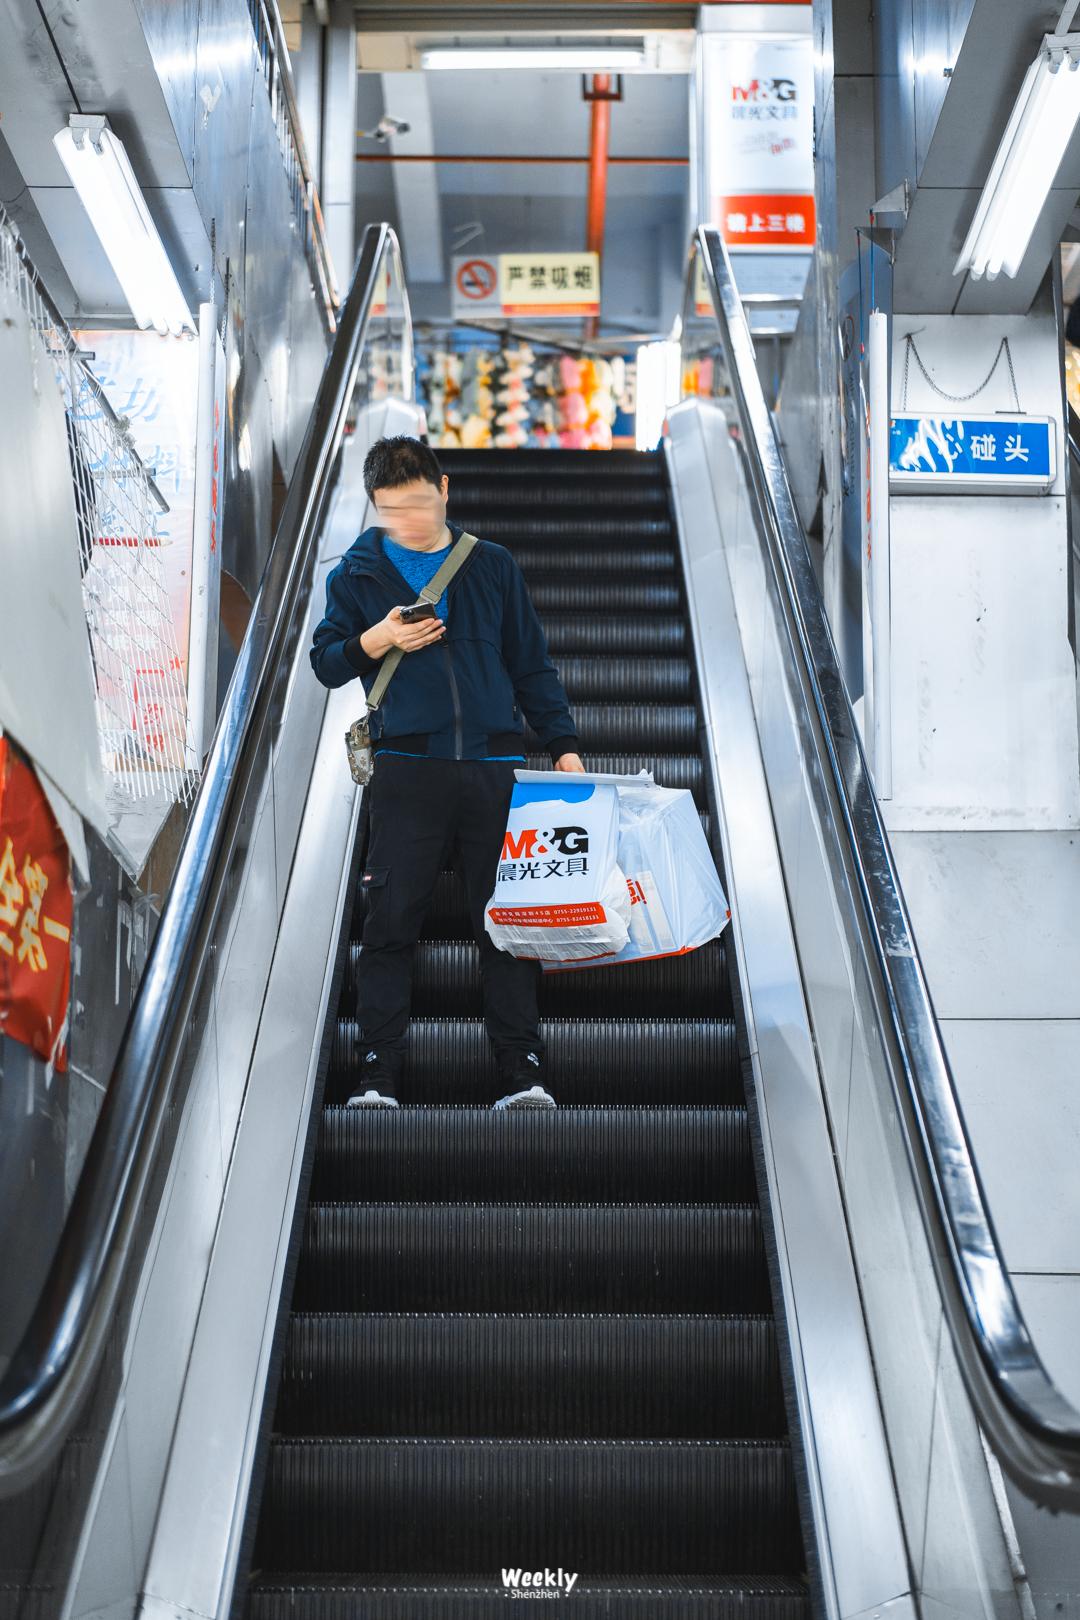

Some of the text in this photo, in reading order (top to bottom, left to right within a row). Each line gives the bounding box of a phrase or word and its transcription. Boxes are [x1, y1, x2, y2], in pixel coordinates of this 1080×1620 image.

[732, 79, 797, 102] M&G
[507, 265, 593, 291] 严禁吸烟
[501, 826, 588, 860] M&G
[498, 858, 589, 881] 晨光文具
